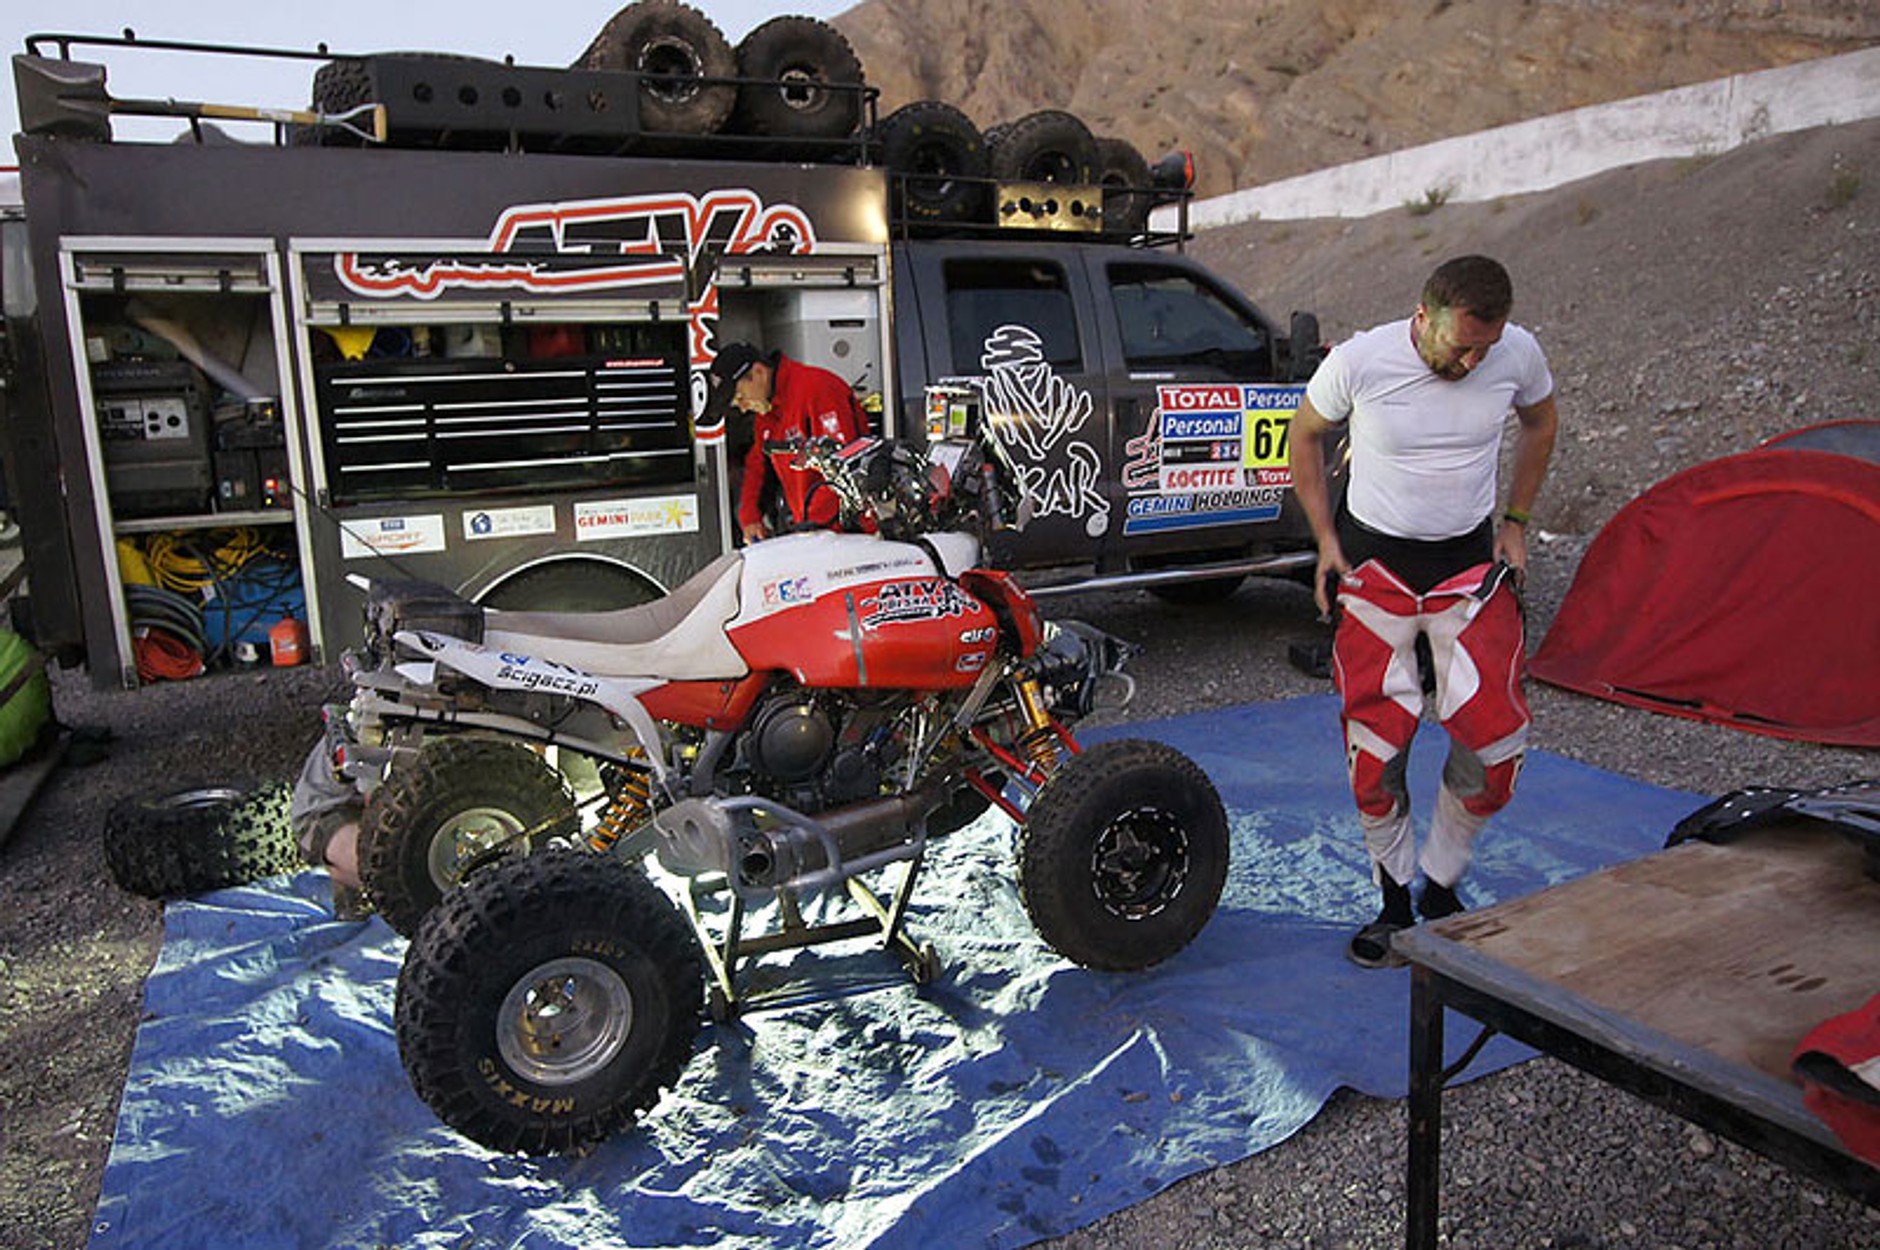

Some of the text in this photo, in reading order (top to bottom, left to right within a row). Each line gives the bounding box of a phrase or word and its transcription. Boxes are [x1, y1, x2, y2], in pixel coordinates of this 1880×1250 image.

[1163, 389, 1238, 408] TOTAL
[1247, 390, 1301, 408] Person
[1165, 414, 1239, 436] Personal
[1166, 469, 1236, 489] LOCTITE
[1129, 486, 1284, 517] GEMINI HOLDINGS
[577, 511, 630, 528] GEMINI
